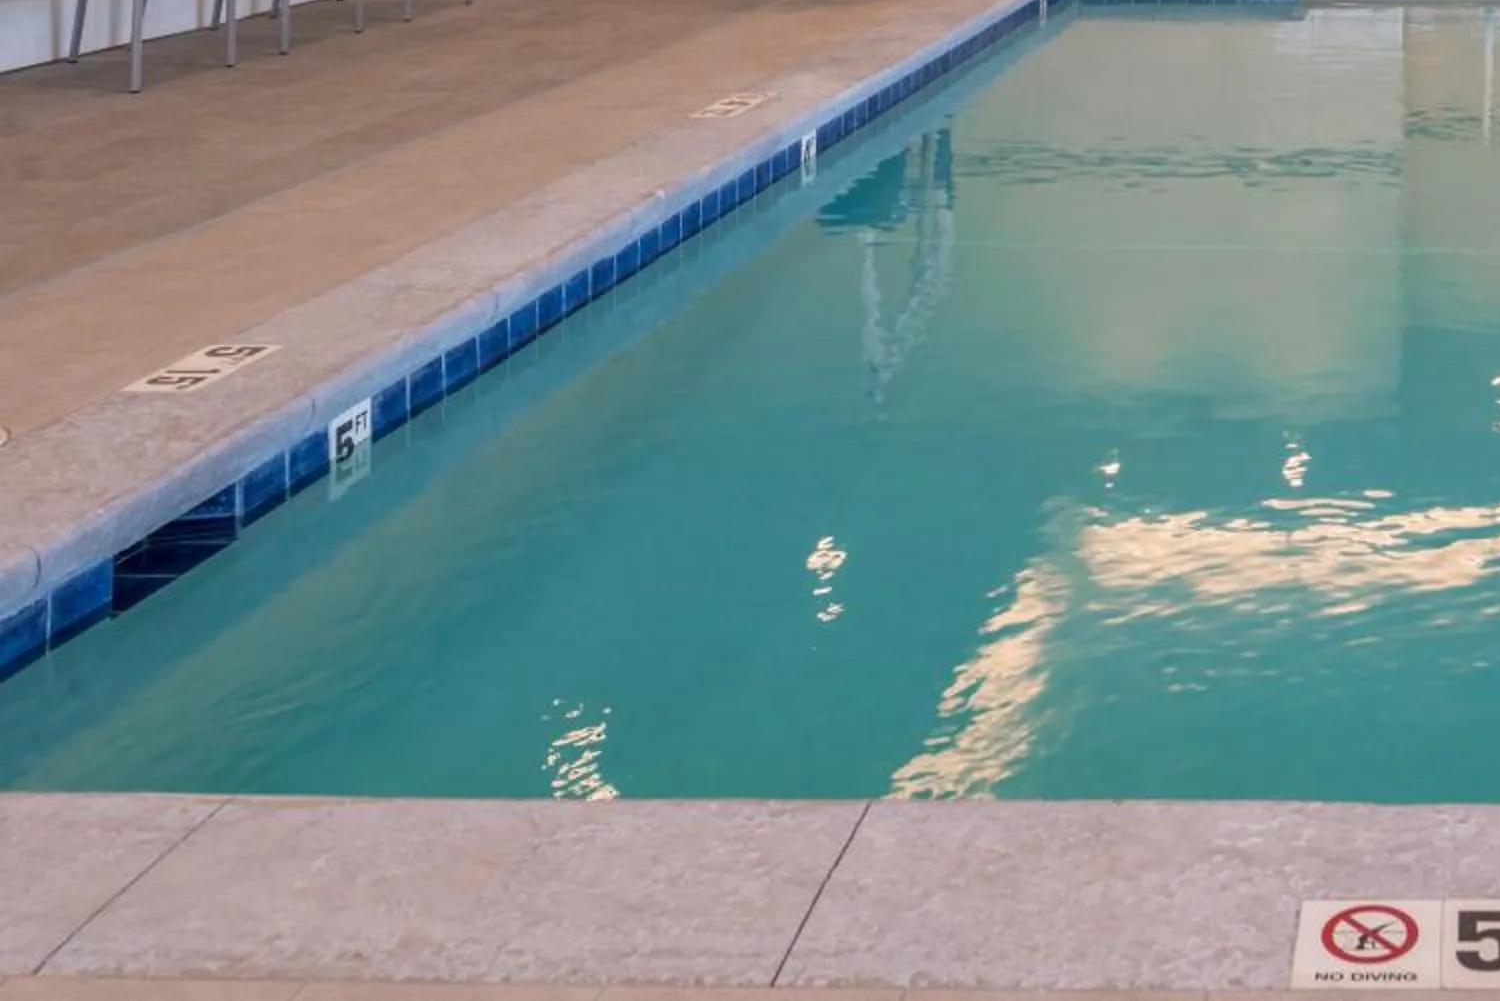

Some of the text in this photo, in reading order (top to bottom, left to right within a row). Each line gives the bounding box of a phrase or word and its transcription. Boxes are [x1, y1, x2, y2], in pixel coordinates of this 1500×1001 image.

[335, 410, 368, 463] 5 FT
[1314, 971, 1417, 981] NO DIVING
